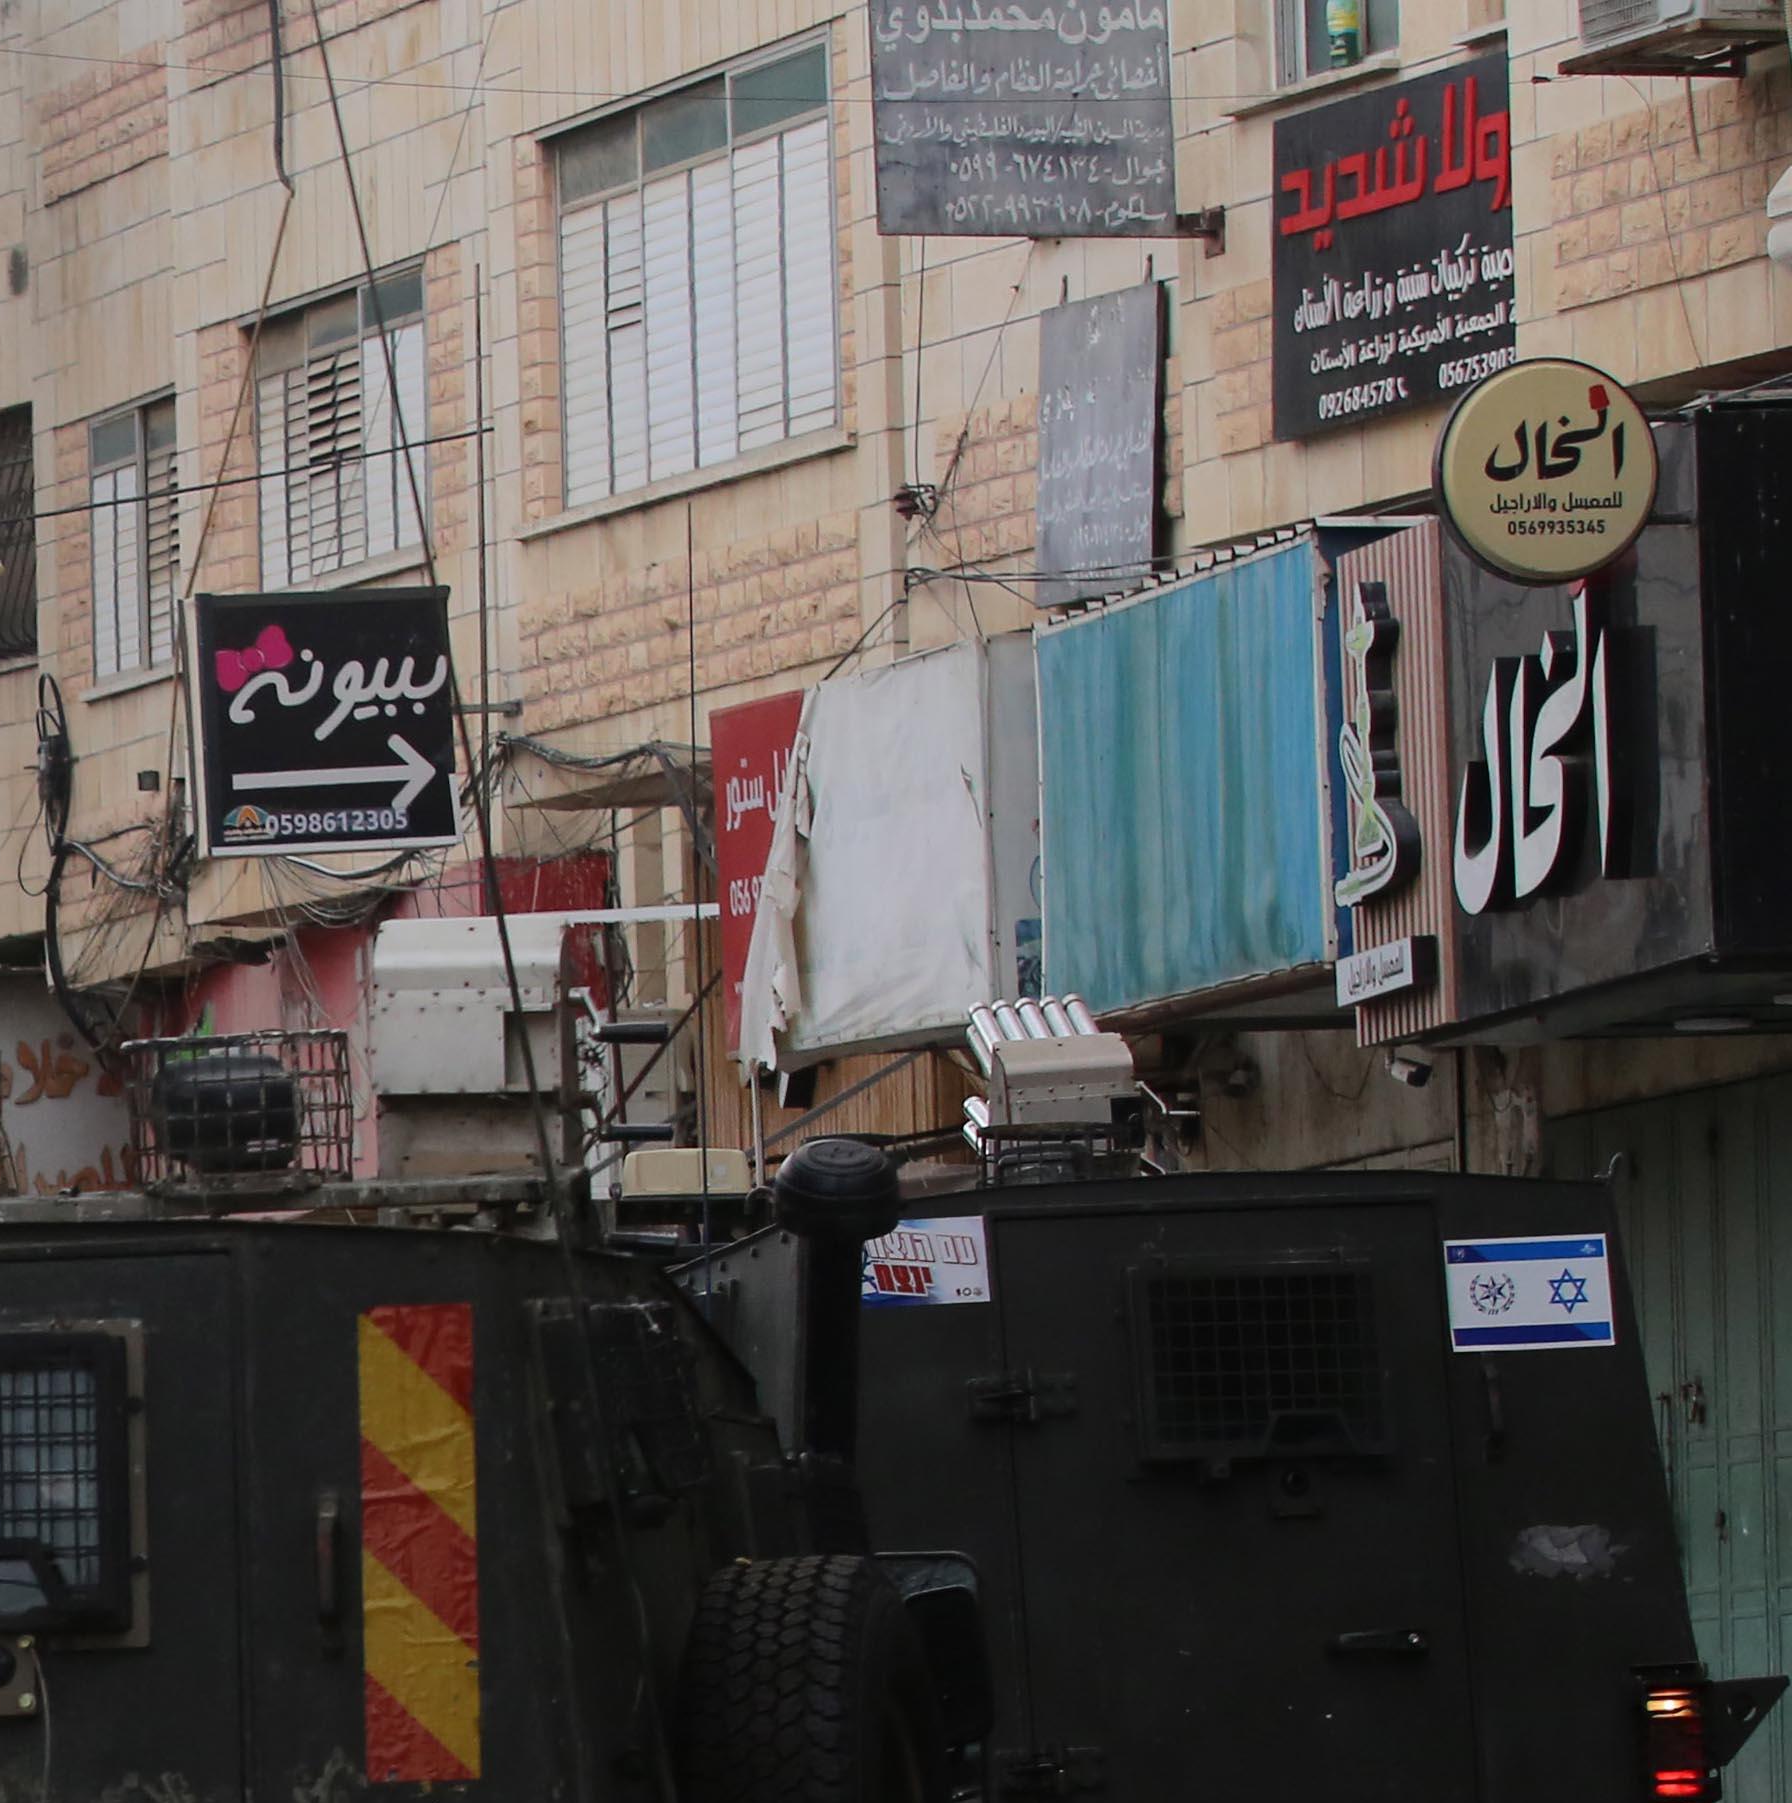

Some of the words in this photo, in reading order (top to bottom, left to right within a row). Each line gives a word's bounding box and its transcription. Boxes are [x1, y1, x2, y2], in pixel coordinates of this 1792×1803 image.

[1280, 98, 1428, 252] شديد
[1484, 400, 1624, 482] الخال
[1489, 492, 1558, 515] والاراجيل
[1507, 519, 1606, 536] 0569935345
[1561, 491, 1624, 514] للمعسل
[1454, 588, 1610, 917] الخال
[725, 756, 765, 833] ستور
[267, 808, 409, 836] 0598612305
